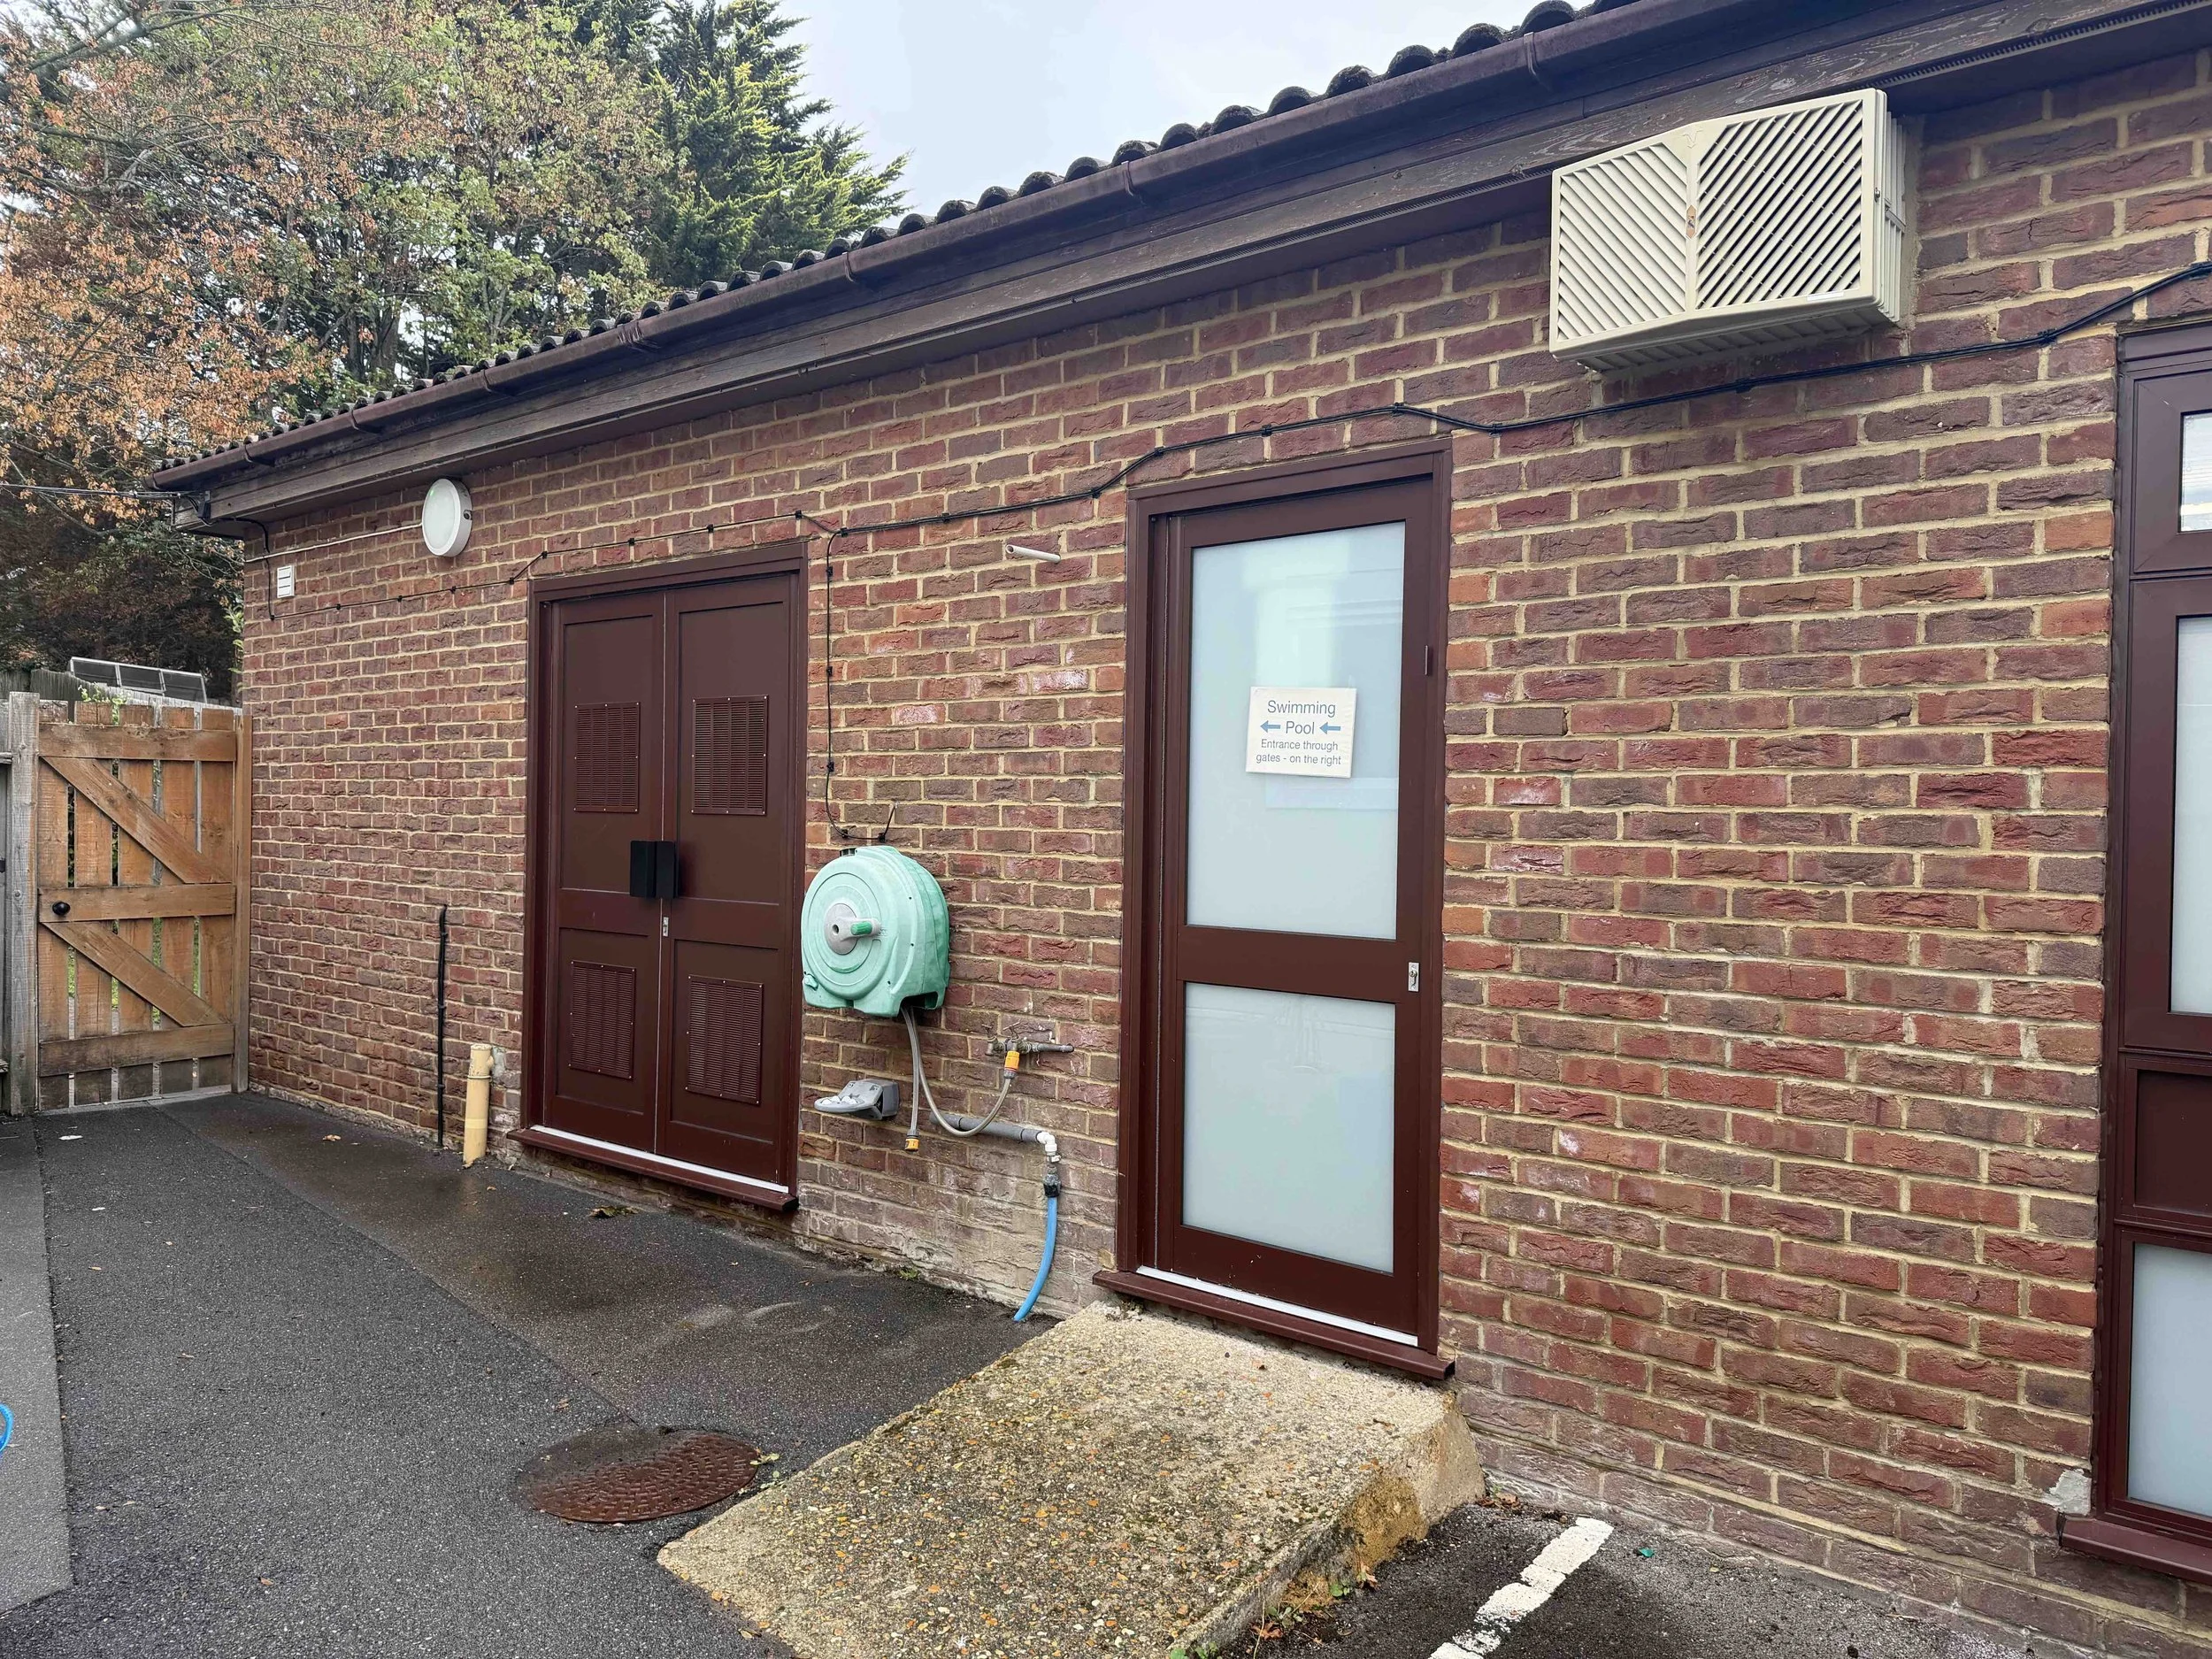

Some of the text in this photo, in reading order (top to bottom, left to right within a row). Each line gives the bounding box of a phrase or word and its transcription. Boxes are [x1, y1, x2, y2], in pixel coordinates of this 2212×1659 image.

[1267, 700, 1336, 718] Swimming
[1286, 721, 1315, 734] Pool
[1261, 739, 1338, 752] Entrance through
[1256, 754, 1280, 764] gates
[1303, 755, 1318, 764] the
[1320, 755, 1341, 766] right
